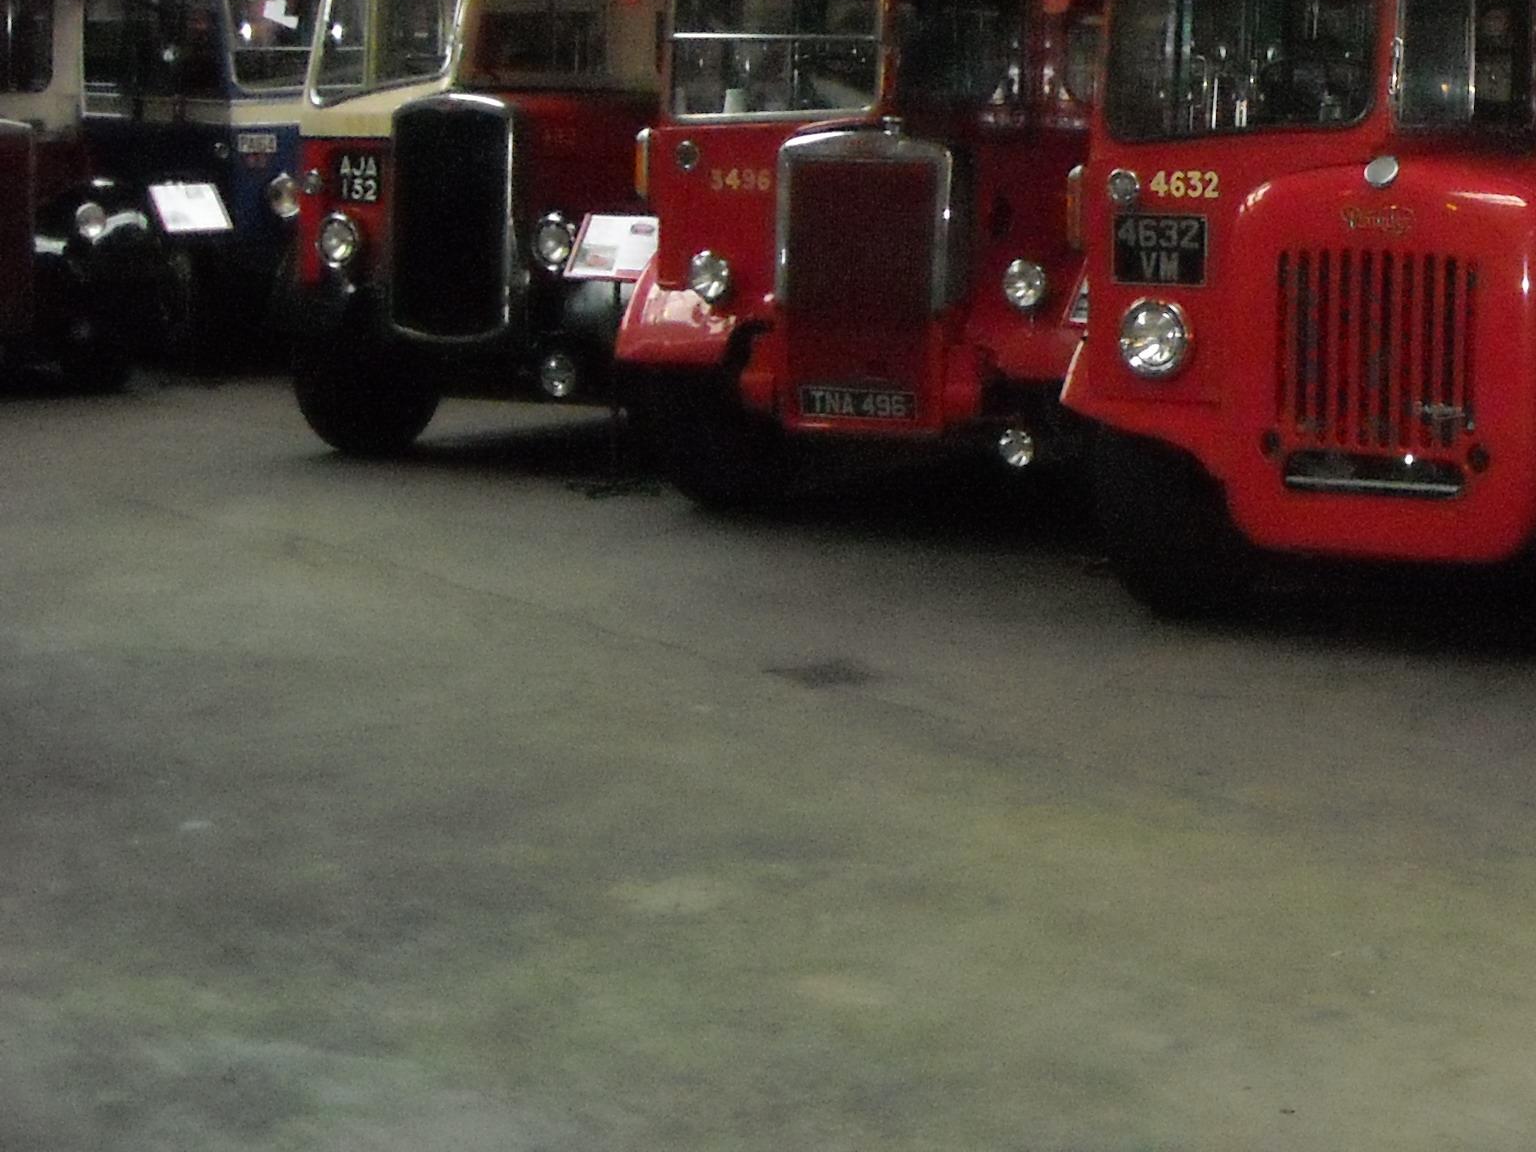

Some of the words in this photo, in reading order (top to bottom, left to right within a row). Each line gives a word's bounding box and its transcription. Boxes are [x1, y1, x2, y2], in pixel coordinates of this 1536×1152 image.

[340, 155, 377, 176] AJA
[342, 178, 377, 200] 152
[1150, 171, 1219, 198] 4632
[1117, 219, 1199, 248] 4632
[1139, 251, 1180, 281] VM
[810, 391, 854, 414] TNA
